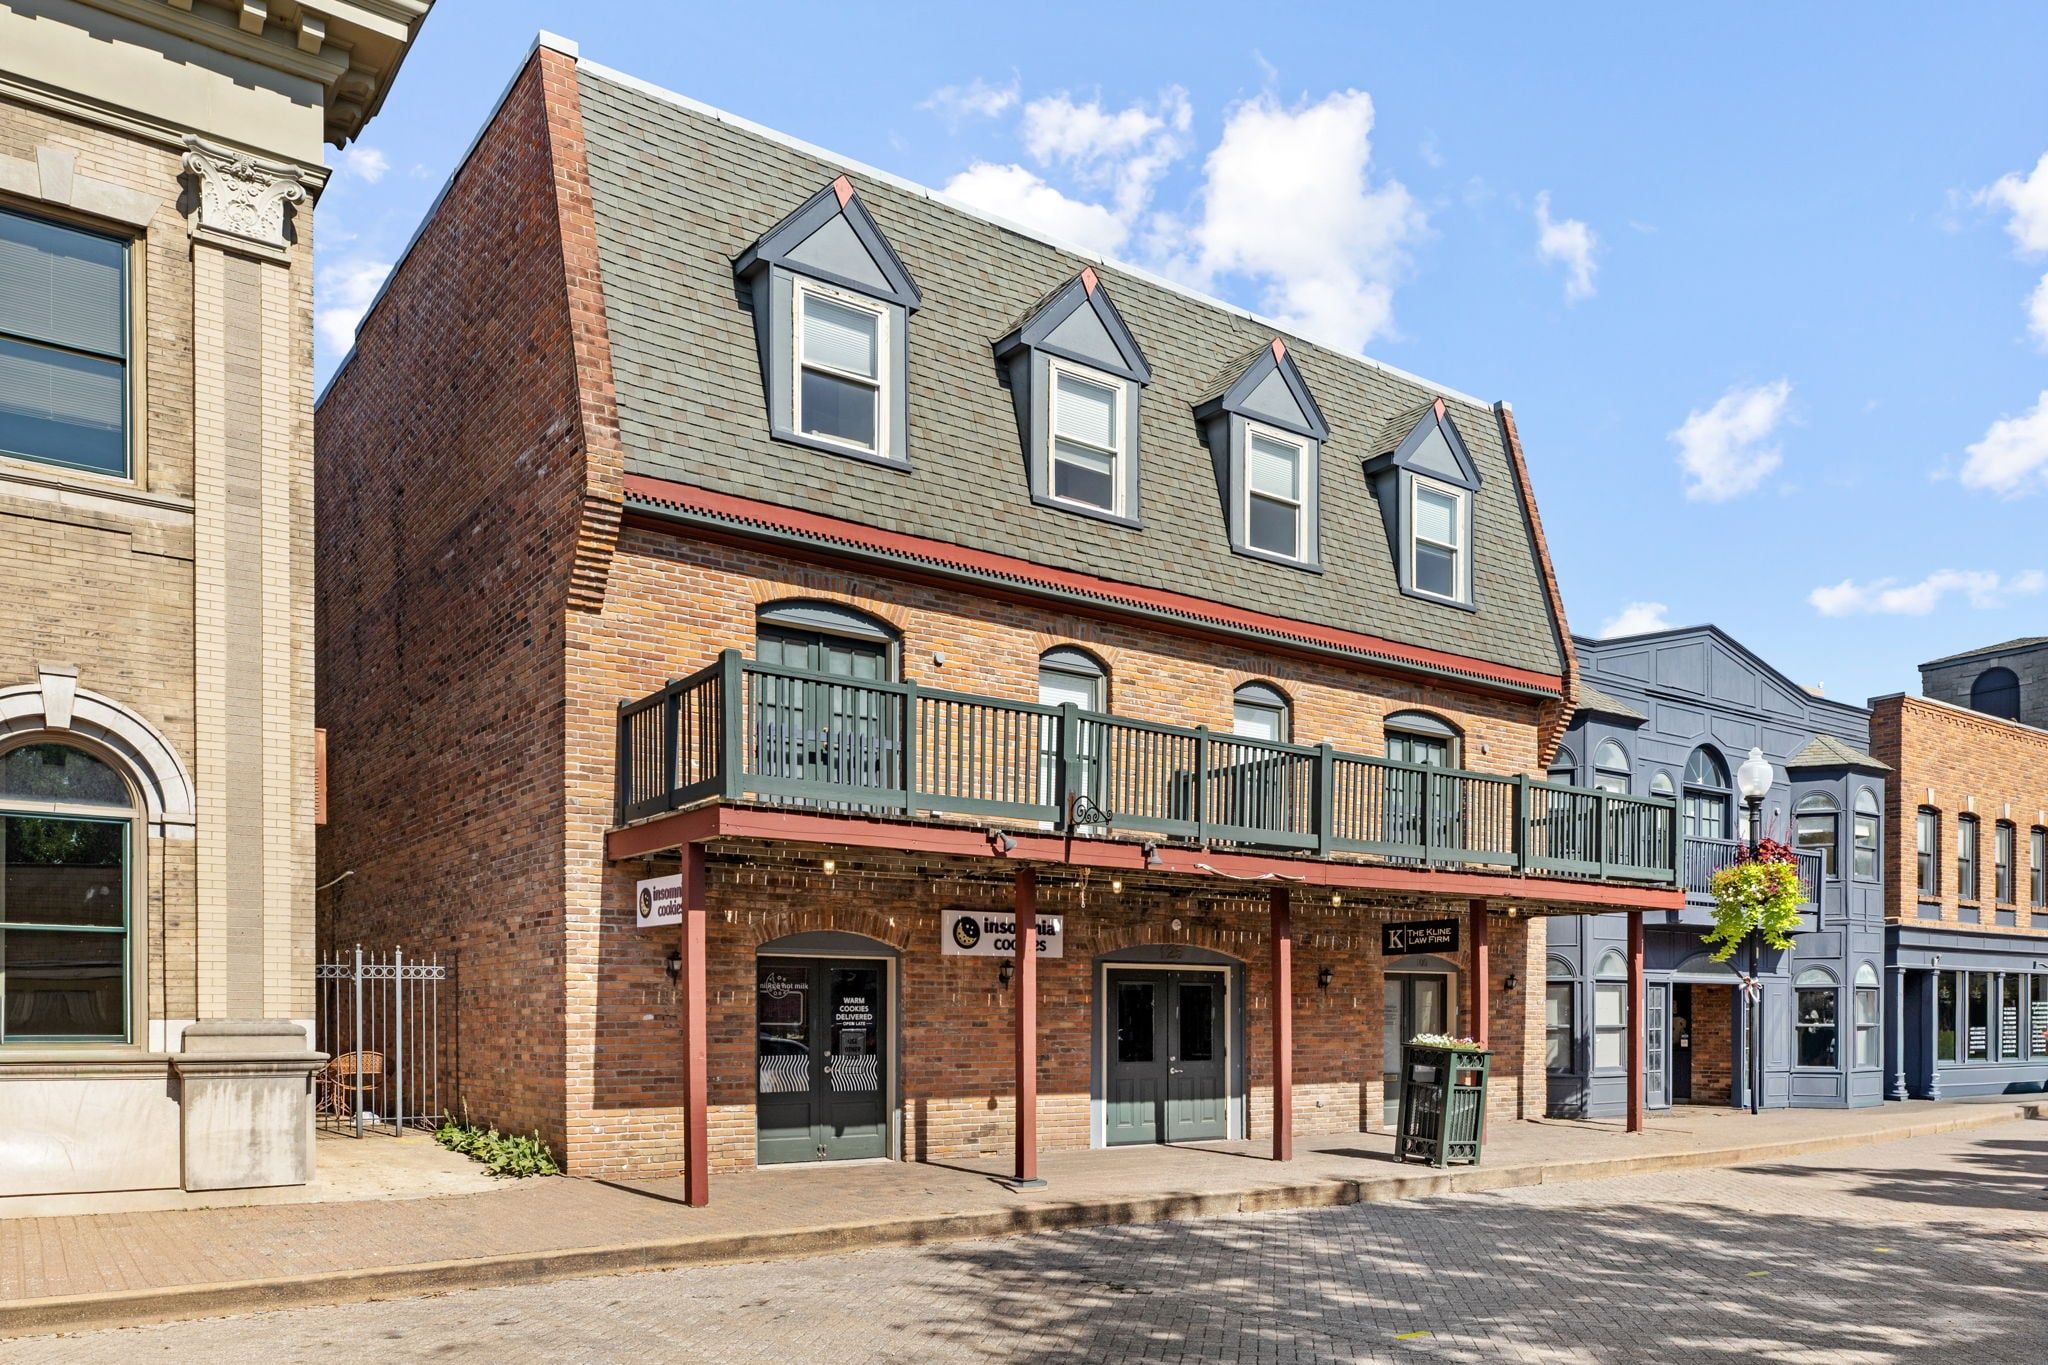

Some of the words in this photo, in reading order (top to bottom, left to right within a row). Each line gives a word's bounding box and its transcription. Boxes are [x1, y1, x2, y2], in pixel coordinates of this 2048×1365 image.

[653, 886, 682, 901] insomn
[984, 918, 1056, 936] insonia
[1407, 929, 1425, 937] THE
[1426, 927, 1452, 936] KLINE
[1388, 929, 1404, 949] K
[1408, 937, 1427, 945] LAW
[1428, 935, 1450, 943] FIRM
[993, 938, 1047, 952] cooes
[794, 982, 809, 990] milk
[839, 1005, 869, 1013] COOKIES
[835, 1013, 873, 1021] DELIVERED
